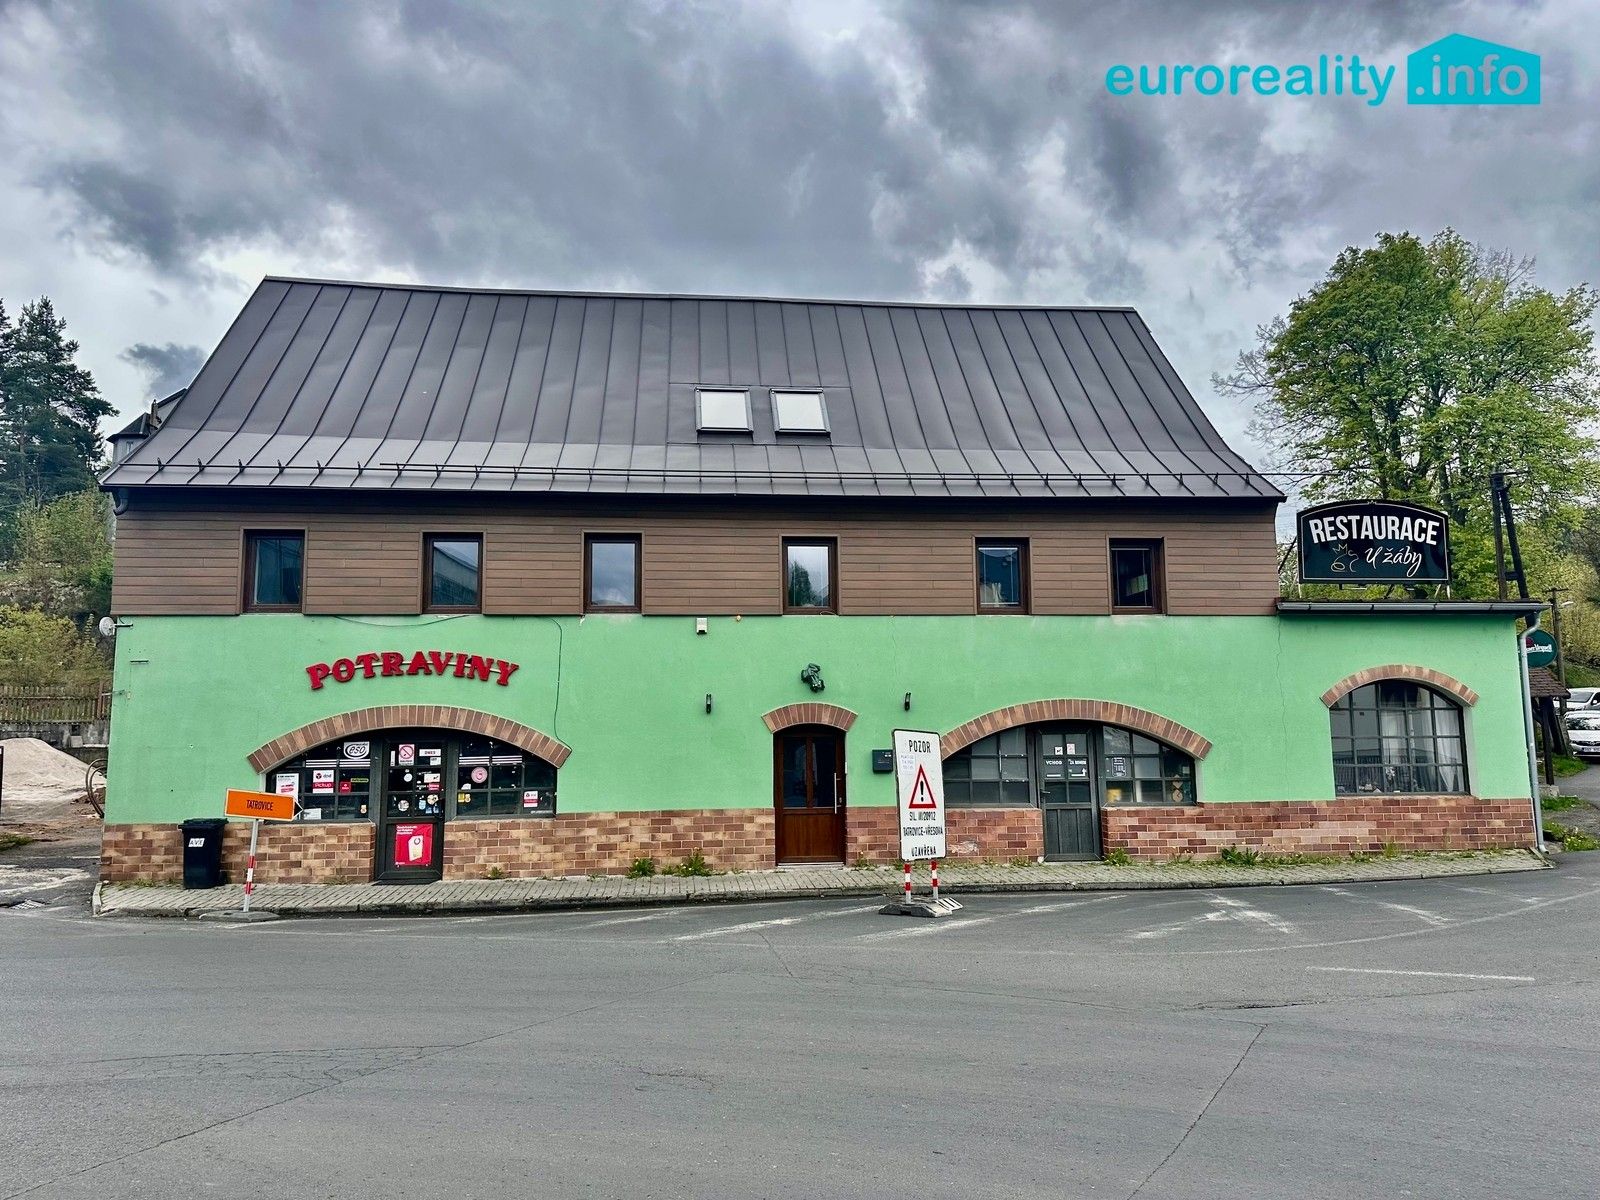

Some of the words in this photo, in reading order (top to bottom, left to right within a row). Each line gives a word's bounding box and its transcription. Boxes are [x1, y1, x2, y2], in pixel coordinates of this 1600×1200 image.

[1308, 515, 1440, 546] RESTAURACE
[1364, 546, 1384, 570] U
[1382, 545, 1422, 578] žáby
[305, 650, 520, 690] POTRAVINY
[908, 739, 931, 753] POZOR
[246, 799, 274, 811] TATROVICE
[911, 844, 937, 857] UZAVŘENA
